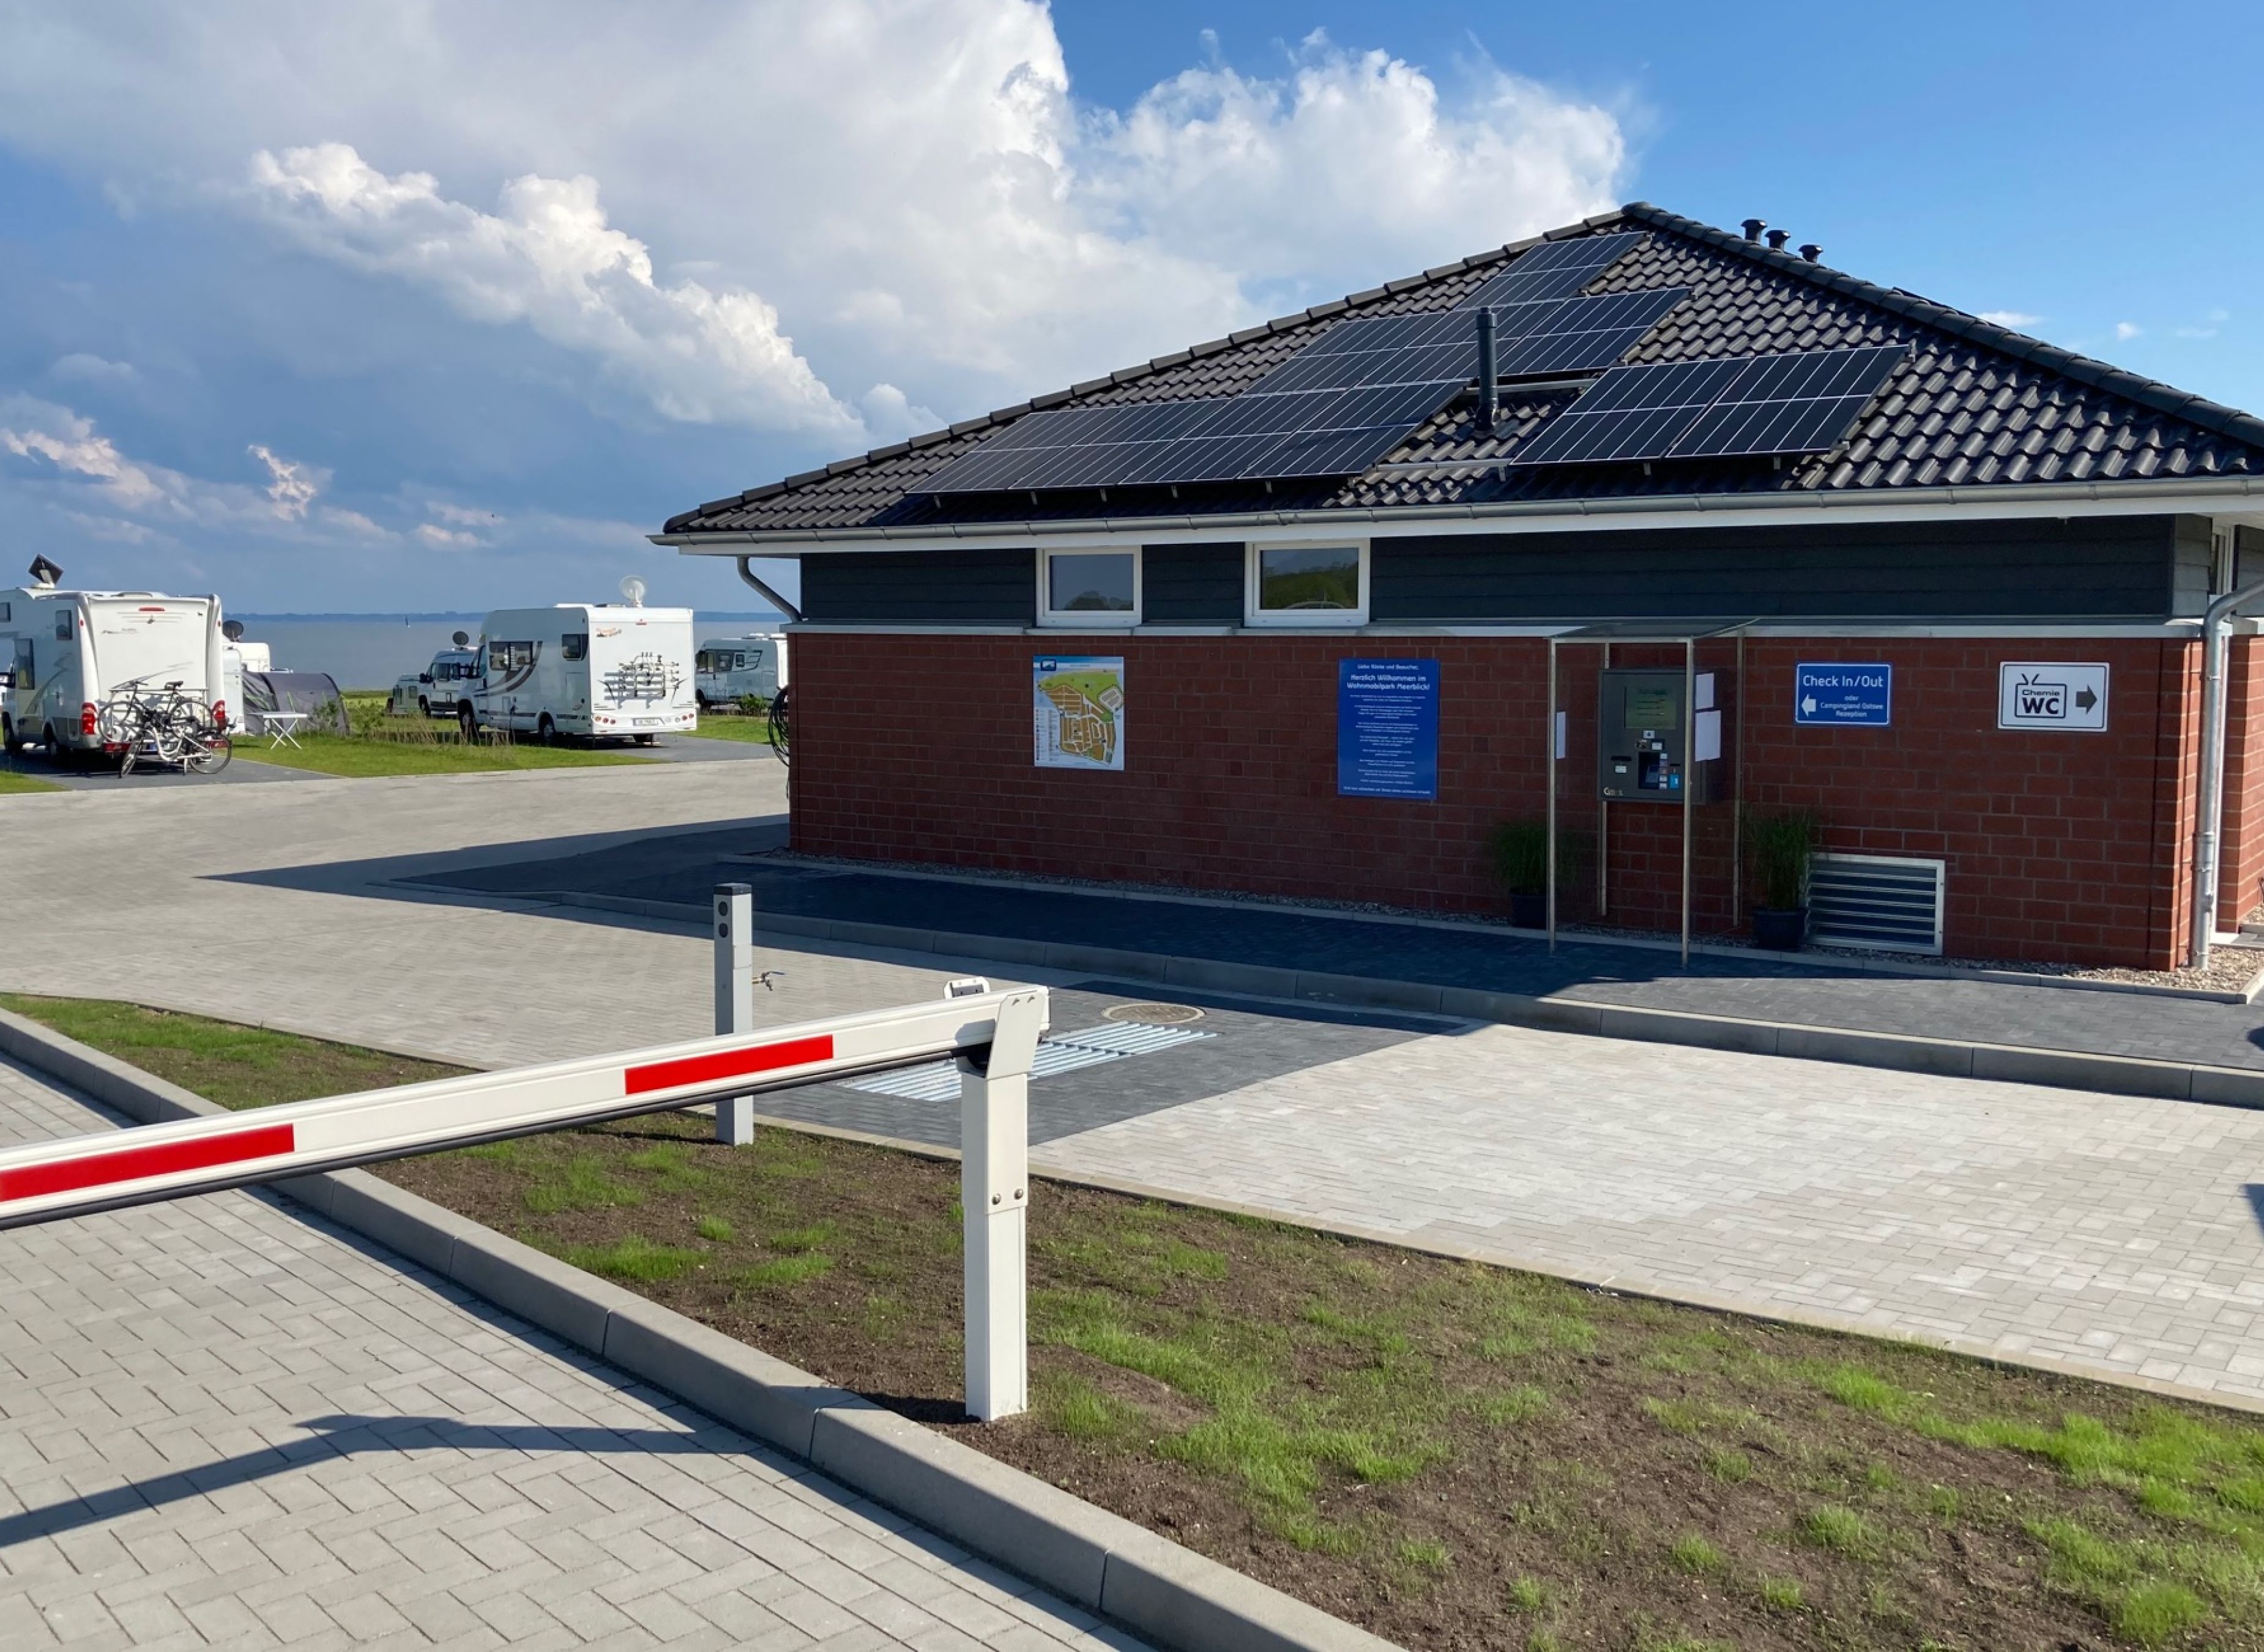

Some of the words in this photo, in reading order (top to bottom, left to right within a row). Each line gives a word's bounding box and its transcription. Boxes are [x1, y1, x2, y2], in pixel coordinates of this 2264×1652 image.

[1803, 675, 1839, 686] Check
[1842, 675, 1883, 687] In/Out
[2022, 697, 2059, 715] WC
